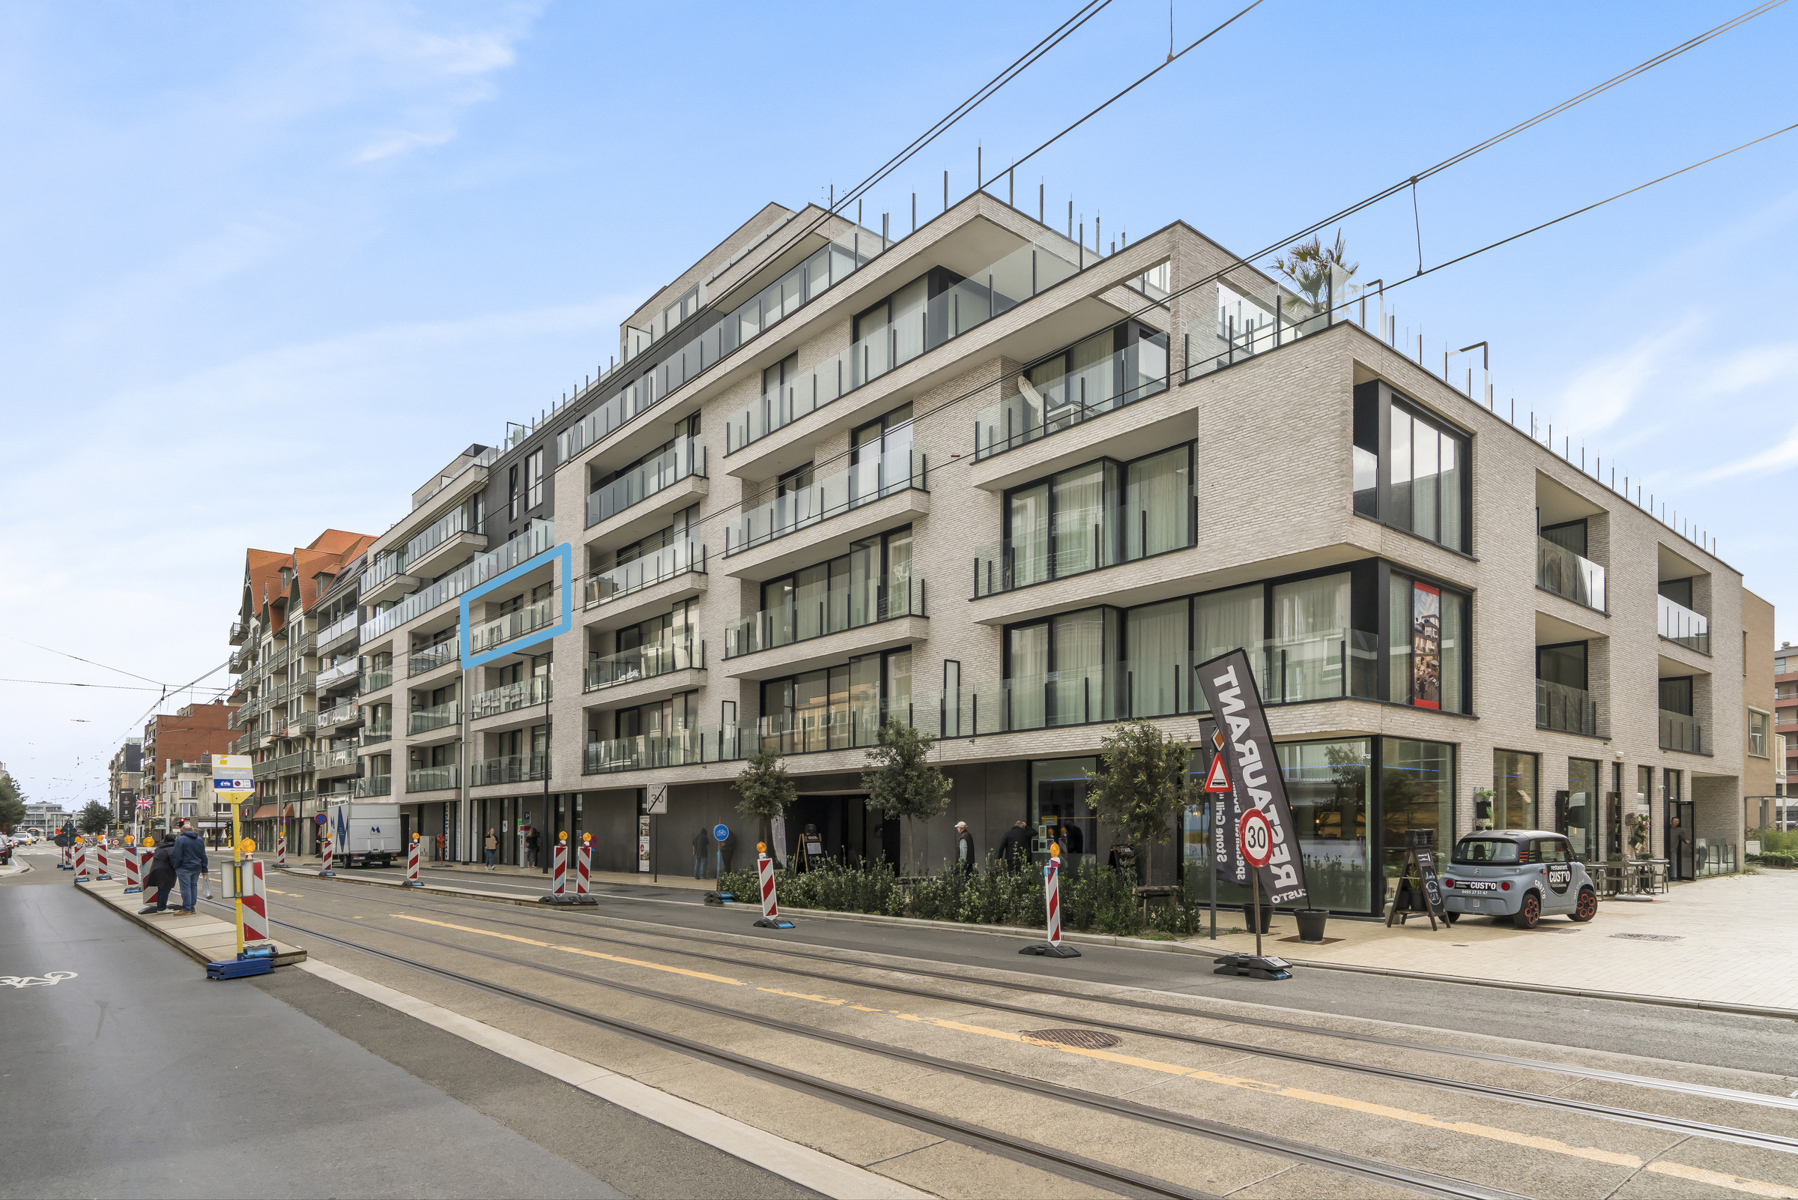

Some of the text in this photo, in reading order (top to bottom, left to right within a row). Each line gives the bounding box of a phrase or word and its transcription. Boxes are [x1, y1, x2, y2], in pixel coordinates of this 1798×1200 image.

[651, 794, 664, 803] 30
[1247, 825, 1266, 850] 30
[1549, 871, 1570, 883] CUST'O
[1470, 881, 1497, 890] CUST'O
